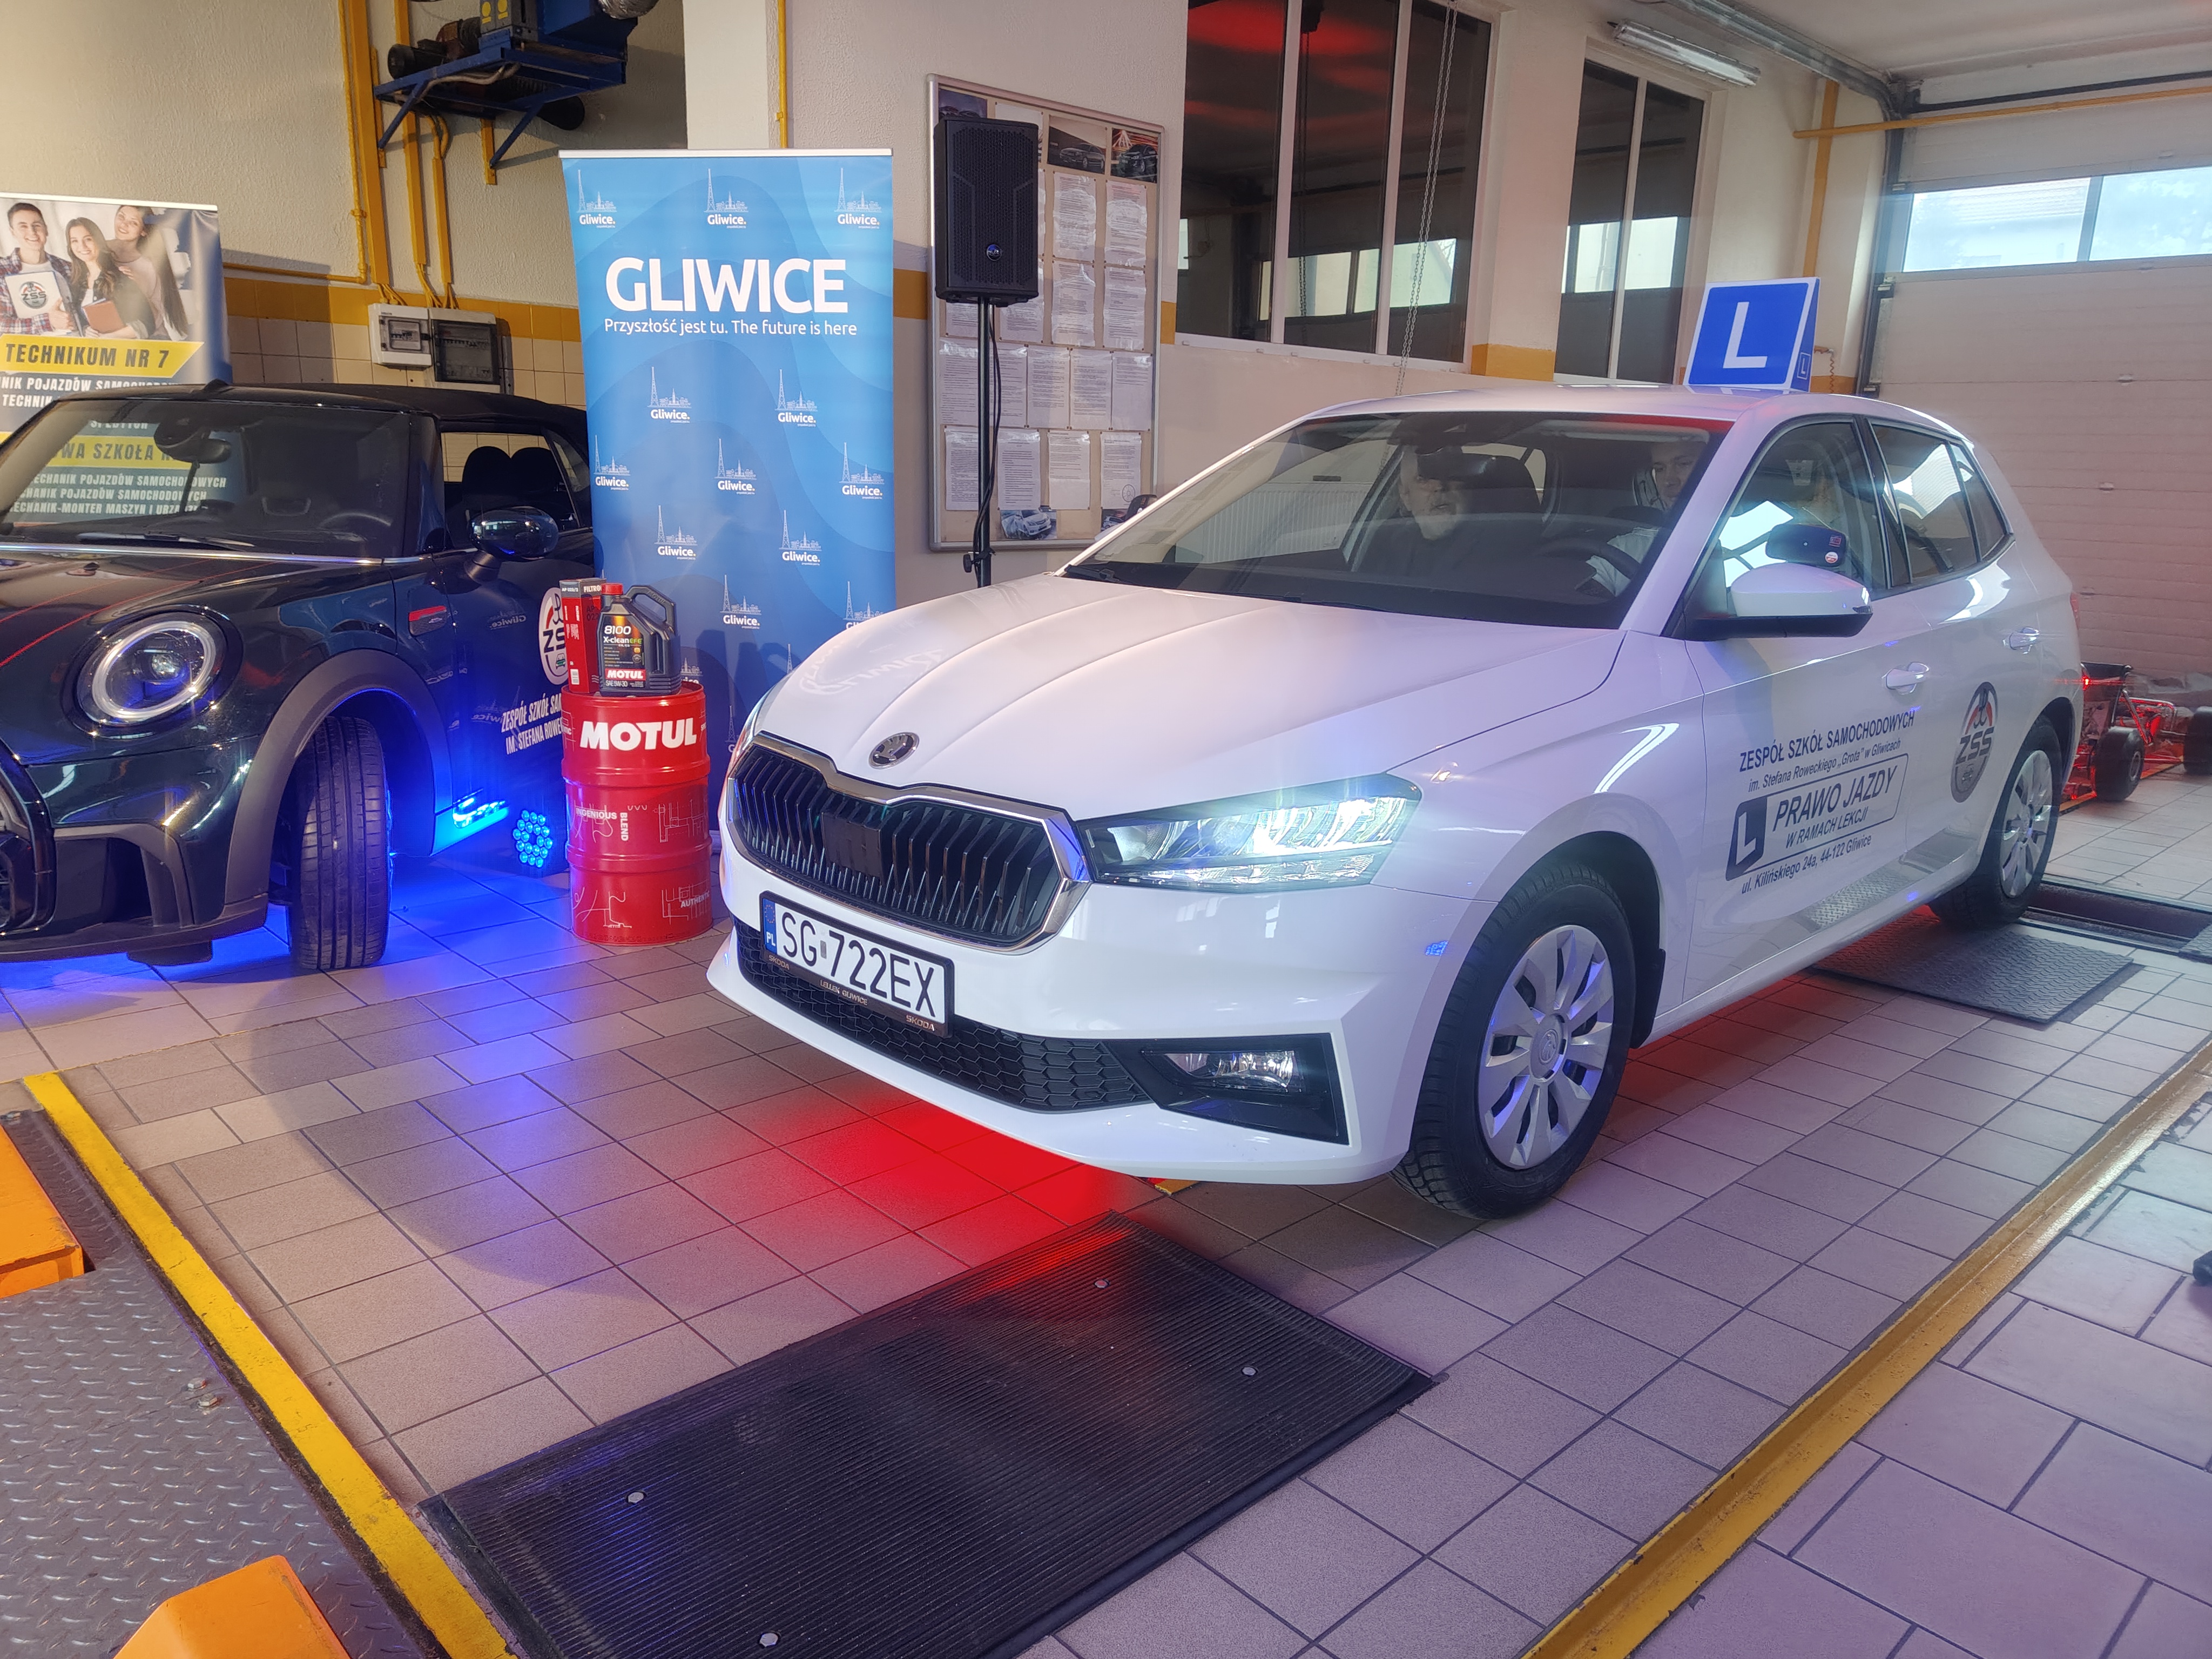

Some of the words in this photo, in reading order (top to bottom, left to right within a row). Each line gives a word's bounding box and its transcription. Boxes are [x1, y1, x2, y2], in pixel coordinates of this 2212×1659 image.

[579, 213, 616, 225] Gliwice.
[707, 213, 747, 225] Gliwice.
[837, 213, 880, 226] Gliwice.
[605, 257, 848, 314] GLIWICE
[21, 291, 46, 301] ZSS
[604, 318, 678, 335] Przyszłość
[678, 320, 706, 336] jest
[710, 321, 729, 334] tu.
[732, 320, 758, 334] The
[761, 319, 807, 335] future
[810, 320, 821, 335] is
[824, 320, 858, 336] here
[1723, 301, 1768, 369] L
[6, 343, 117, 367] TECHNIKUM
[125, 349, 150, 368] NR
[158, 350, 170, 368] 7
[1800, 358, 1806, 375] L
[26, 377, 92, 392] POJAZDÓW
[650, 409, 690, 420] Gliwice.
[778, 413, 817, 423] Gliwice.
[93, 443, 154, 461] SZKOŁA
[32, 473, 77, 484] ECHANIK
[80, 473, 134, 485] POJAZDÓW
[137, 475, 227, 488] SAMOCHOOWYCH
[595, 476, 629, 487] Gliwice.
[717, 480, 756, 491] Gliwice.
[60, 487, 115, 500] POJAZDÓW
[842, 484, 883, 496] Gliwice.
[10, 501, 103, 514] ECHANIK-MONTER
[106, 502, 145, 515] MASZYN
[149, 504, 153, 515] I
[657, 545, 696, 557] Gliwice.
[782, 551, 821, 563] Gliwice.
[583, 584, 602, 592] FILTRO
[723, 614, 760, 626] Gliwice.
[604, 625, 631, 635] 8100
[543, 627, 566, 653] ZS
[607, 670, 643, 679] MOTUL
[501, 700, 528, 733] ZESPÓŁ
[528, 693, 549, 723] SZKÓŁ
[506, 735, 517, 755] IM.
[518, 724, 544, 750] STEFANA
[579, 717, 697, 751] MOTUL
[1739, 739, 1784, 772] ZESPÓŁ
[1788, 729, 1823, 759] SZKÓŁ
[1826, 710, 1916, 749] SAMOCHODOWYCH
[1955, 726, 1995, 765] ZSS
[1748, 778, 1760, 793] im.
[1763, 771, 1792, 788] Stefana
[1793, 758, 1837, 779] Roweckiego
[1865, 748, 1871, 758] w
[1871, 738, 1901, 757] Gliwicach
[1772, 783, 1842, 832] PRAWO
[1843, 765, 1898, 808] JAZDY
[576, 807, 617, 820] INGENIOUS
[619, 812, 629, 841] BLEND
[1785, 831, 1798, 849] W
[1796, 817, 1837, 845] RAMACH
[1837, 806, 1869, 830] LEKCJI
[1735, 811, 1756, 865] L
[1742, 877, 1752, 894] ul.
[1754, 862, 1800, 889] Kilińskiego
[1820, 842, 1845, 863] 44-122
[1846, 834, 1872, 853] Gliwice
[766, 931, 775, 947] PL
[781, 912, 817, 967] SG
[828, 929, 936, 1018] 722EX
[820, 979, 840, 994] LELLEK
[842, 990, 868, 1006] GLIWICE
